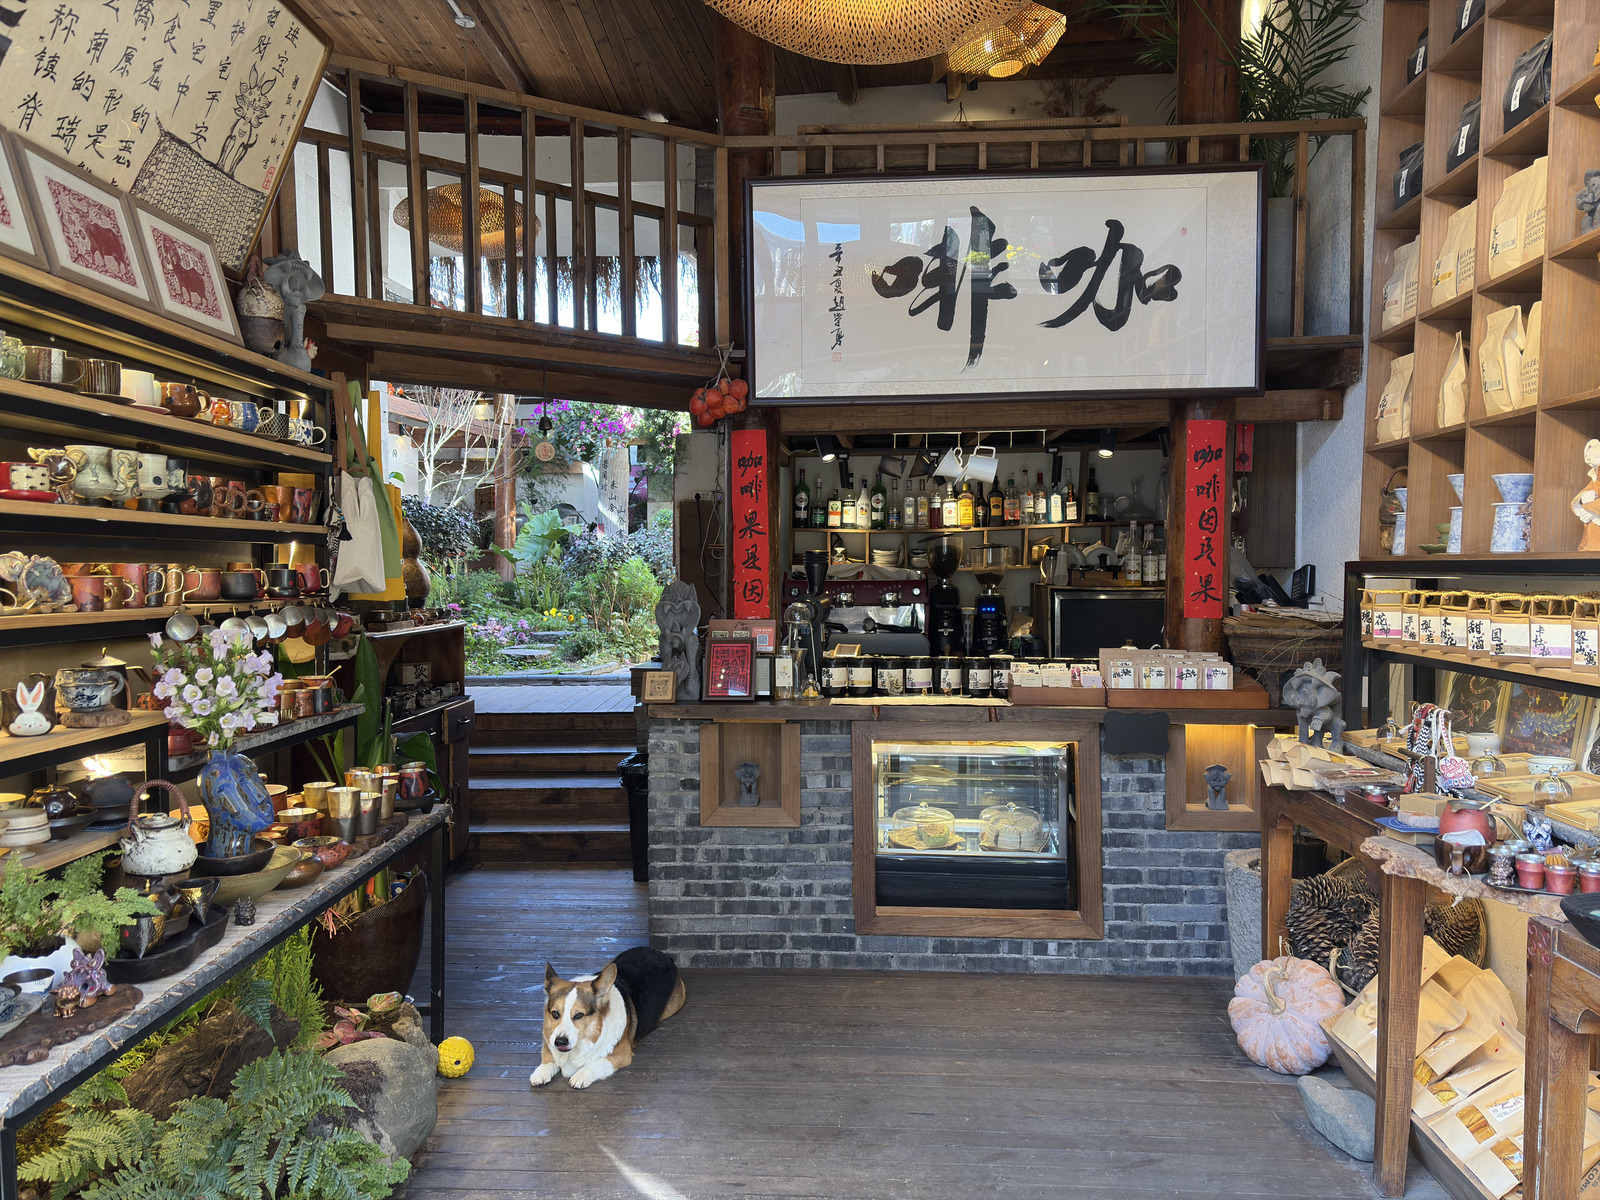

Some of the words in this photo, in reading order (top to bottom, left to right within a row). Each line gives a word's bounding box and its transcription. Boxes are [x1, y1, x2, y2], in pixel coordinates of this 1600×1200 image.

[190, 0, 251, 151] 护宅平安
[872, 206, 1182, 373] 咖啡
[737, 450, 766, 604] 咖啡果是因
[1375, 613, 1391, 637] 花神
[1468, 620, 1485, 650] 甜酒
